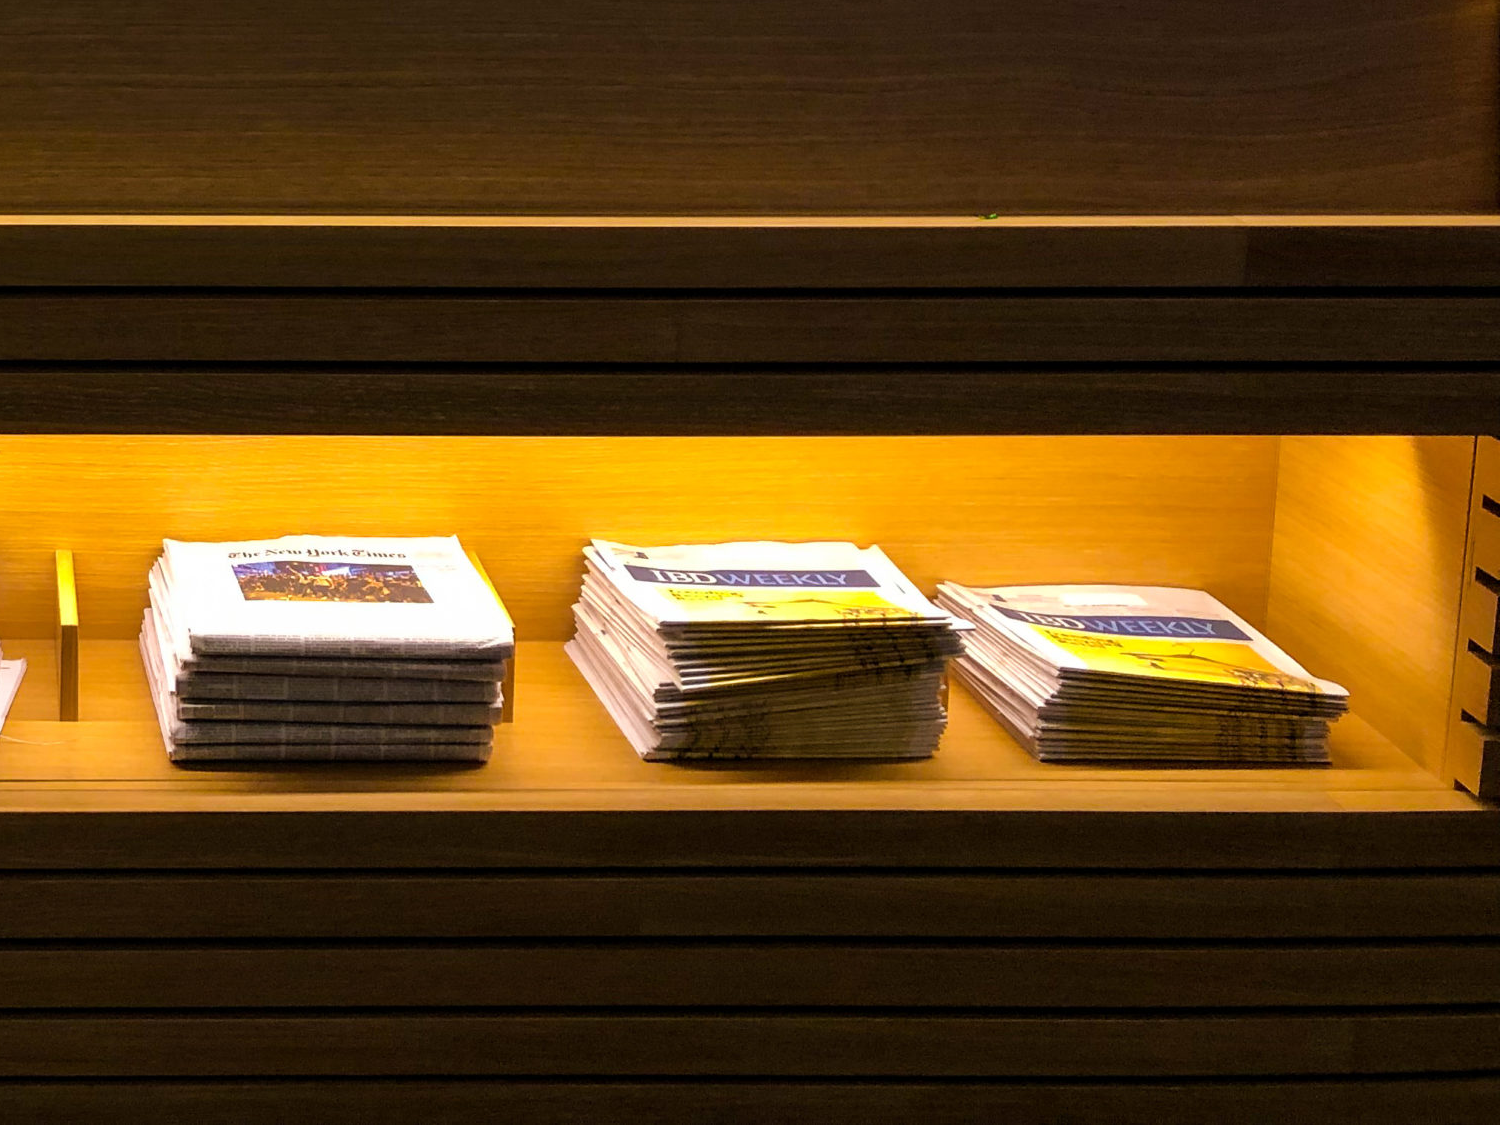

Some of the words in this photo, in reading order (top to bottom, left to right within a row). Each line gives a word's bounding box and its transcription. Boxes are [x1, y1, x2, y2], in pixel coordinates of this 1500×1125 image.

[228, 551, 261, 559] The
[264, 549, 302, 557] New
[304, 548, 351, 558] York
[352, 548, 407, 559] Times
